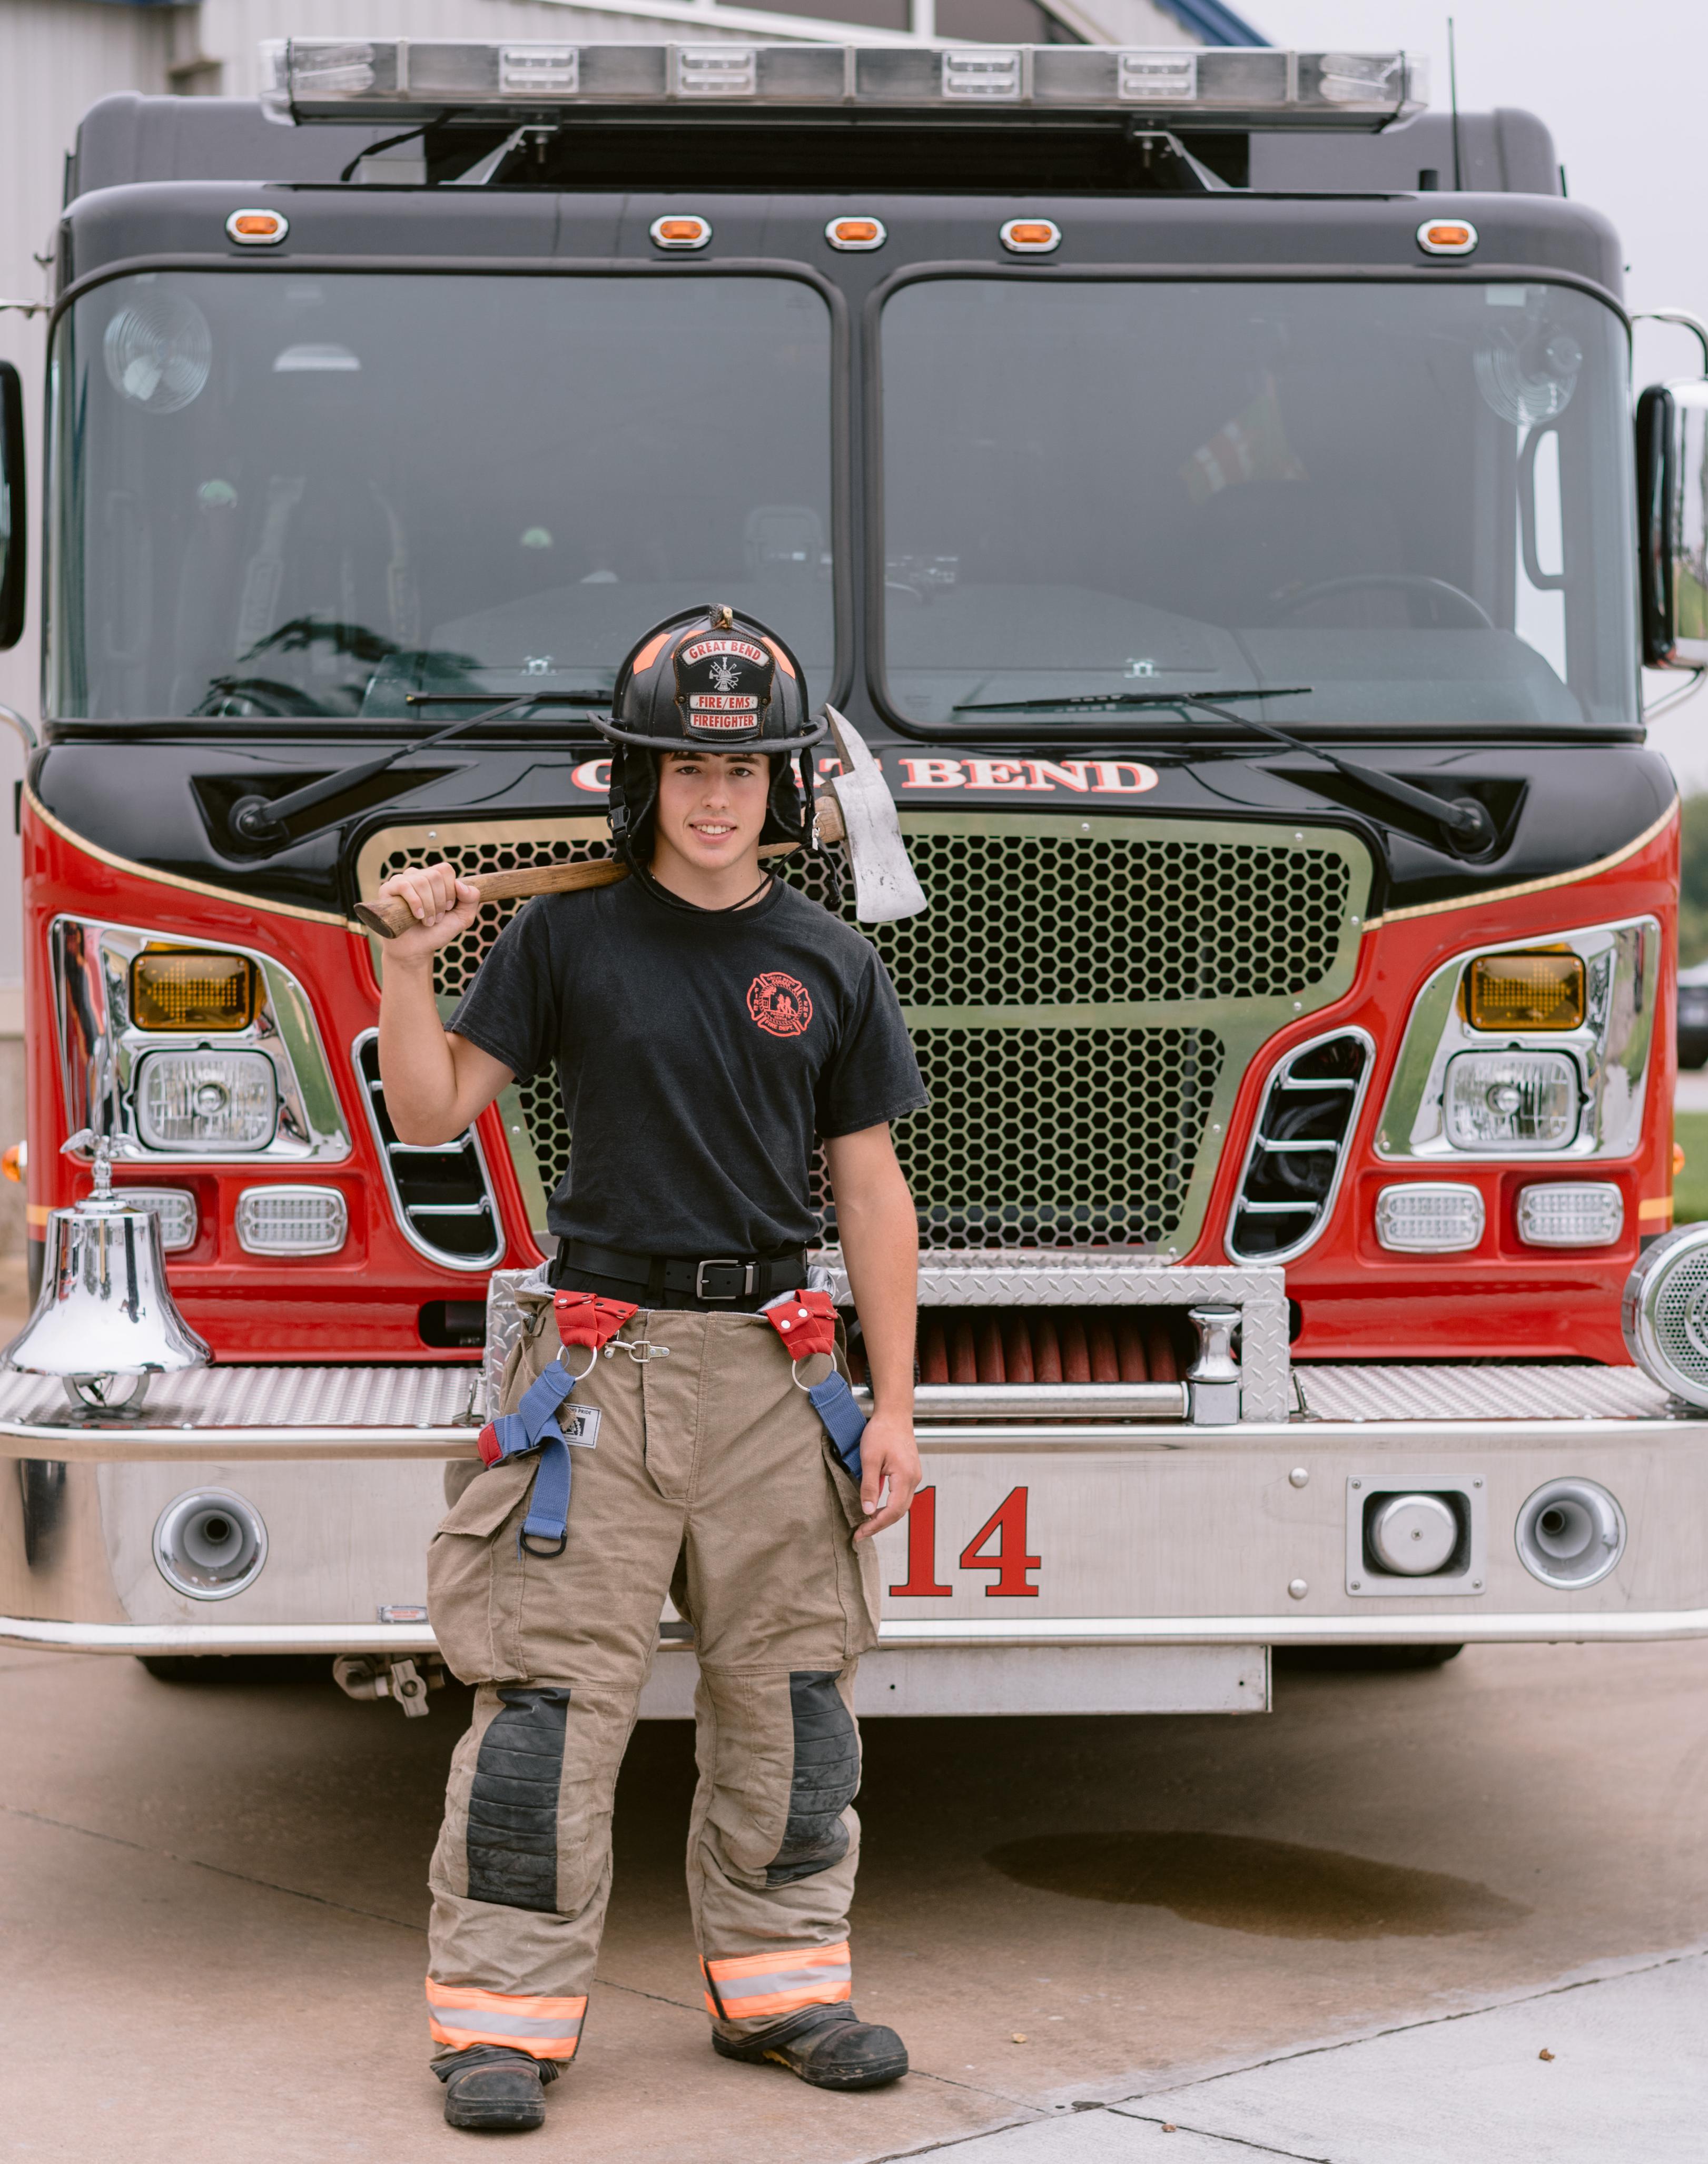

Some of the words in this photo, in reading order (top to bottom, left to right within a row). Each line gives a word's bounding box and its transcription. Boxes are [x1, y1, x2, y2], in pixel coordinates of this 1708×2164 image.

[689, 641, 726, 659] GREAT
[730, 641, 761, 660] BEND
[699, 696, 751, 710] FIRE/EMS
[693, 715, 754, 728] FIREFIGHTER
[899, 758, 1159, 793] BEND
[765, 1020, 778, 1029] FIRE
[888, 1485, 1041, 1597] 14
